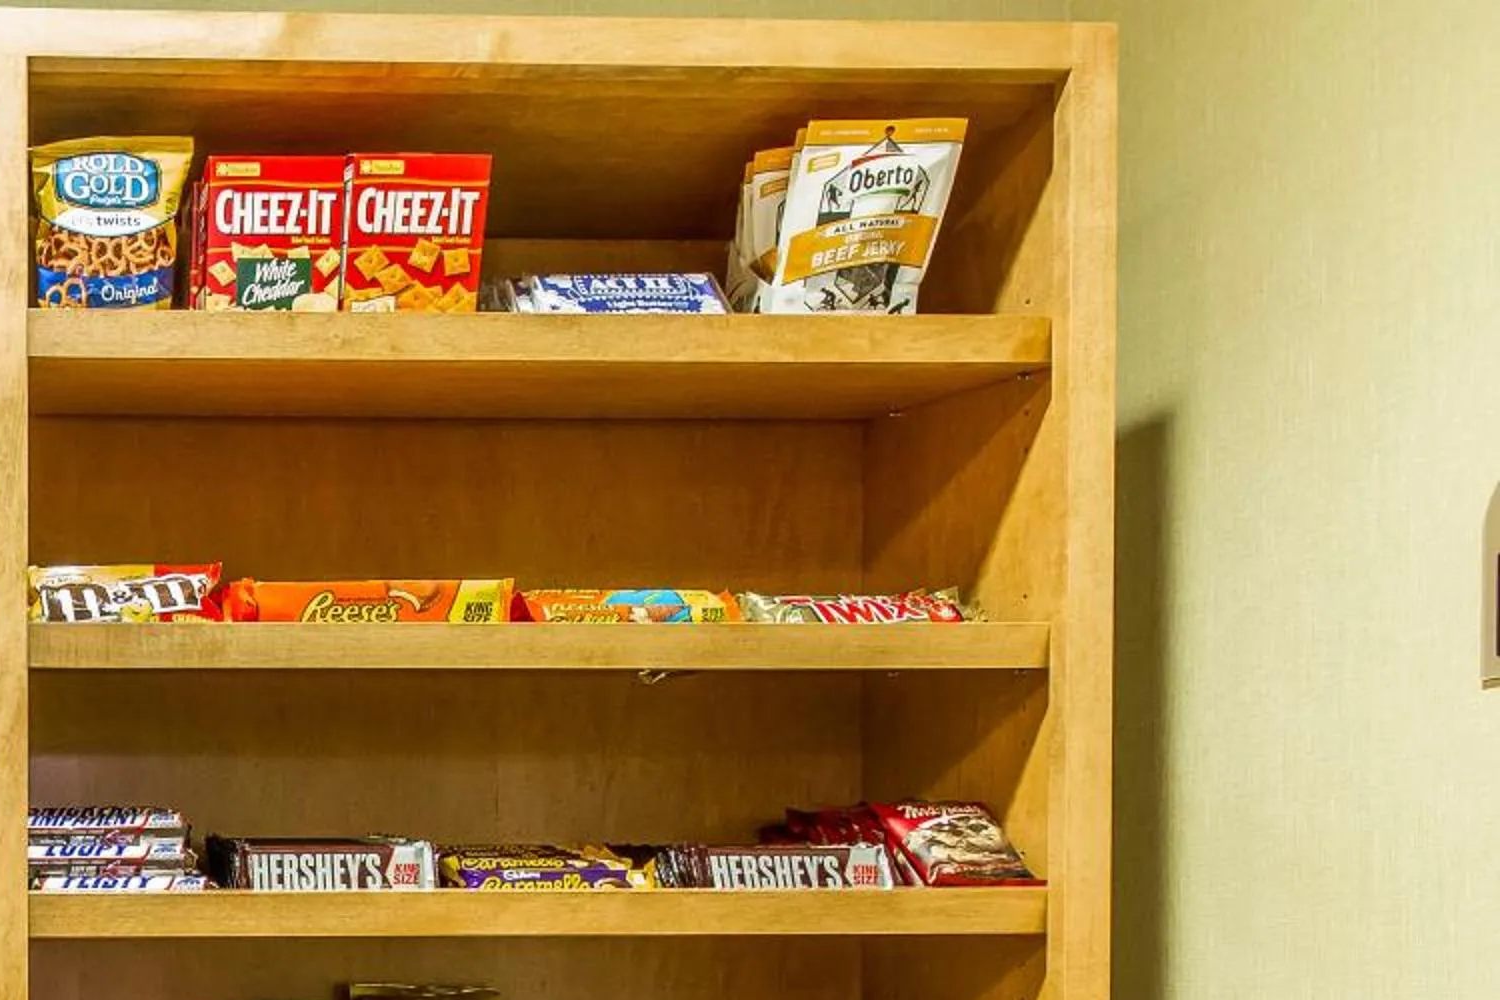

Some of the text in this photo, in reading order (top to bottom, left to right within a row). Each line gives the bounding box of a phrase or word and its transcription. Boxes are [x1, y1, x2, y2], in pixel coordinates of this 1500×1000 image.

[64, 171, 149, 201] GOLD
[850, 166, 913, 193] Oberto
[97, 214, 140, 226] twists
[216, 190, 336, 235] CHEEZ-IT
[357, 187, 479, 235] CHEEZ-IT
[812, 240, 906, 268] BEEF JERKY
[255, 260, 297, 282] White
[100, 278, 158, 303] Original
[242, 279, 303, 306] Cheddar
[301, 591, 400, 622] Reese's
[466, 602, 493, 612] KING
[252, 853, 382, 890] HERSHEY'S
[393, 874, 420, 884] SIZE
[710, 855, 843, 888] HERSHEY'S
